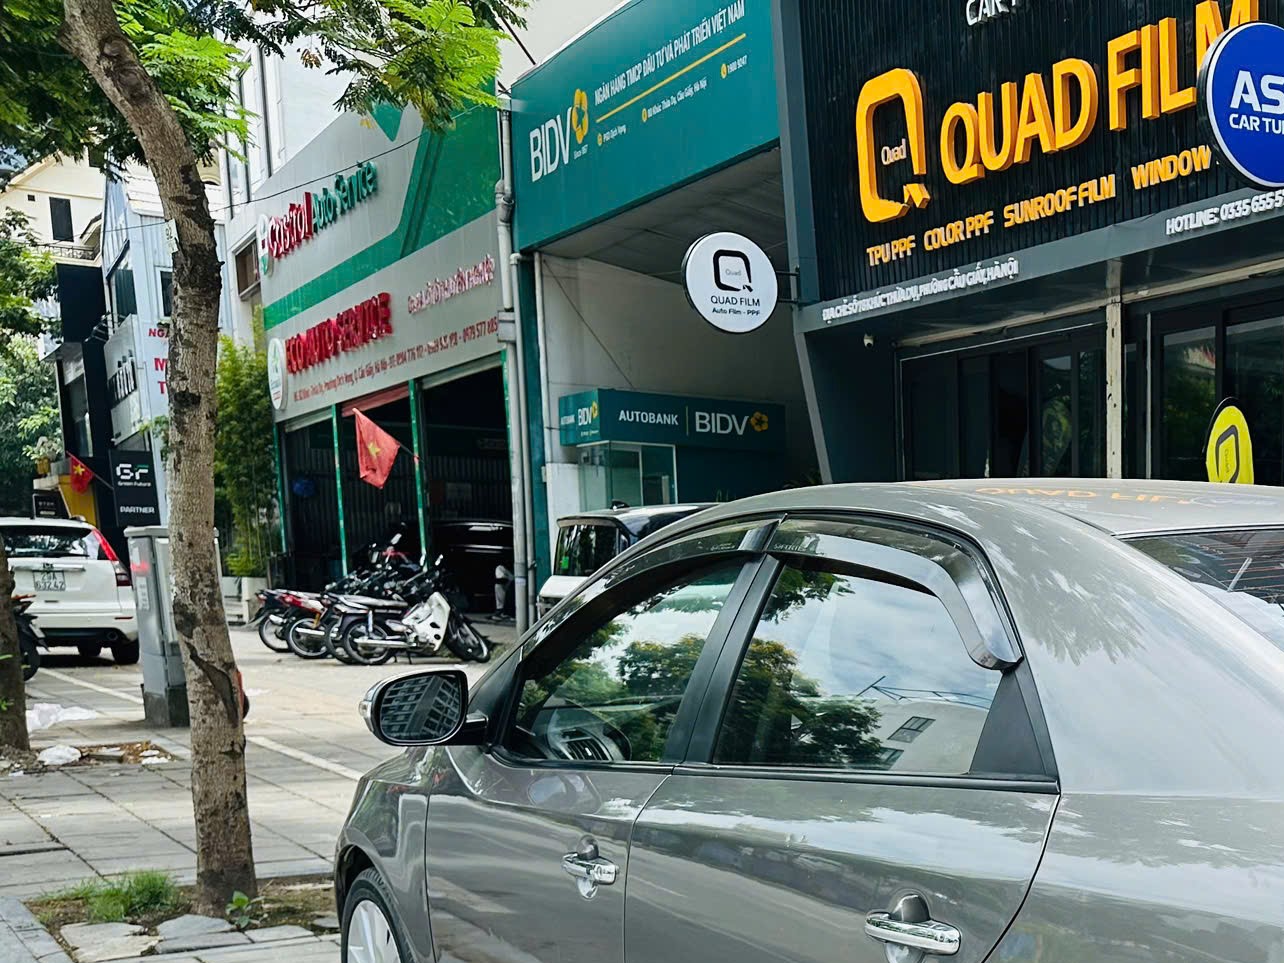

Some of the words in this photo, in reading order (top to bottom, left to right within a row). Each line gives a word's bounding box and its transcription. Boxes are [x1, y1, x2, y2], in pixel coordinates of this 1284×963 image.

[595, 81, 610, 106] NGÂN
[610, 75, 626, 96] HÀNG
[626, 62, 642, 87] TMCP
[643, 53, 656, 77] ĐẦU
[674, 30, 691, 58] PHÁT
[691, 17, 711, 47] TRIỂN
[711, 9, 727, 35] VIỆT
[728, 0, 745, 26] NAM
[940, 58, 1099, 185] QUAD
[1229, 113, 1260, 131] CAR
[530, 107, 572, 182] BIDV
[881, 138, 906, 166] Quad
[866, 242, 891, 266] TPU
[891, 235, 916, 261] PPF
[924, 217, 966, 251] COLOR
[965, 210, 995, 239] PPF
[1003, 186, 1079, 228] SUNROOF
[1078, 173, 1116, 207] FILM
[1131, 144, 1212, 190] WINDOW
[1166, 206, 1220, 235] HOTLINE:
[725, 268, 742, 276] Quad
[710, 295, 738, 306] QUAD
[740, 297, 760, 307] FILM
[577, 405, 593, 426] BIDV
[618, 409, 679, 426] AUTOBANK
[695, 411, 750, 435] BIDV
[120, 506, 155, 514] PARTNER
